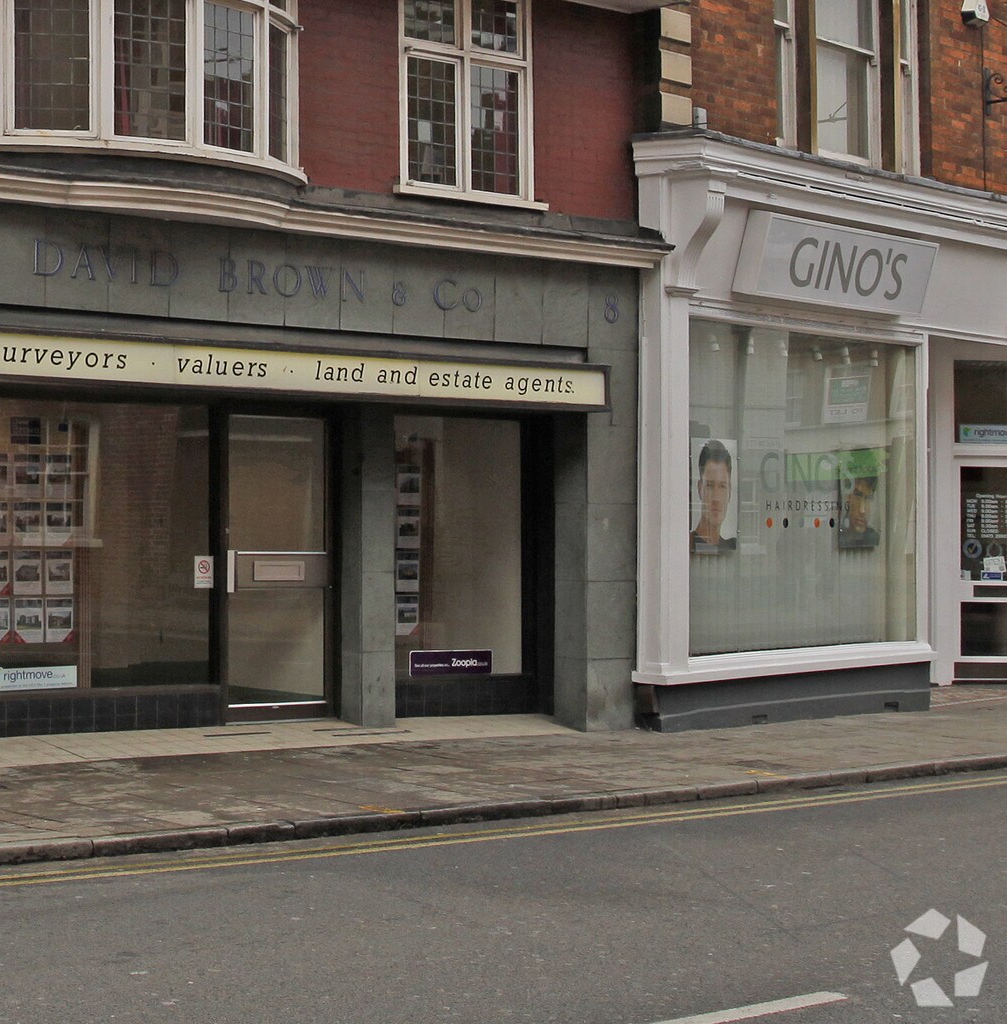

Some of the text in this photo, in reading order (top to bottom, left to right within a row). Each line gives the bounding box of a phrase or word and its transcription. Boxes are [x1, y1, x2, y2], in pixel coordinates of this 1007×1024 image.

[33, 238, 179, 287] DAVID
[218, 257, 365, 302] BROWN
[392, 280, 407, 306] &
[789, 237, 908, 301] GINO'S
[604, 293, 619, 323] 8
[177, 354, 268, 378] valuers
[315, 361, 365, 383] land
[377, 366, 418, 385] and
[429, 372, 493, 390] estate
[505, 376, 575, 396] agents.
[765, 500, 851, 512] HAIRDRESSING
